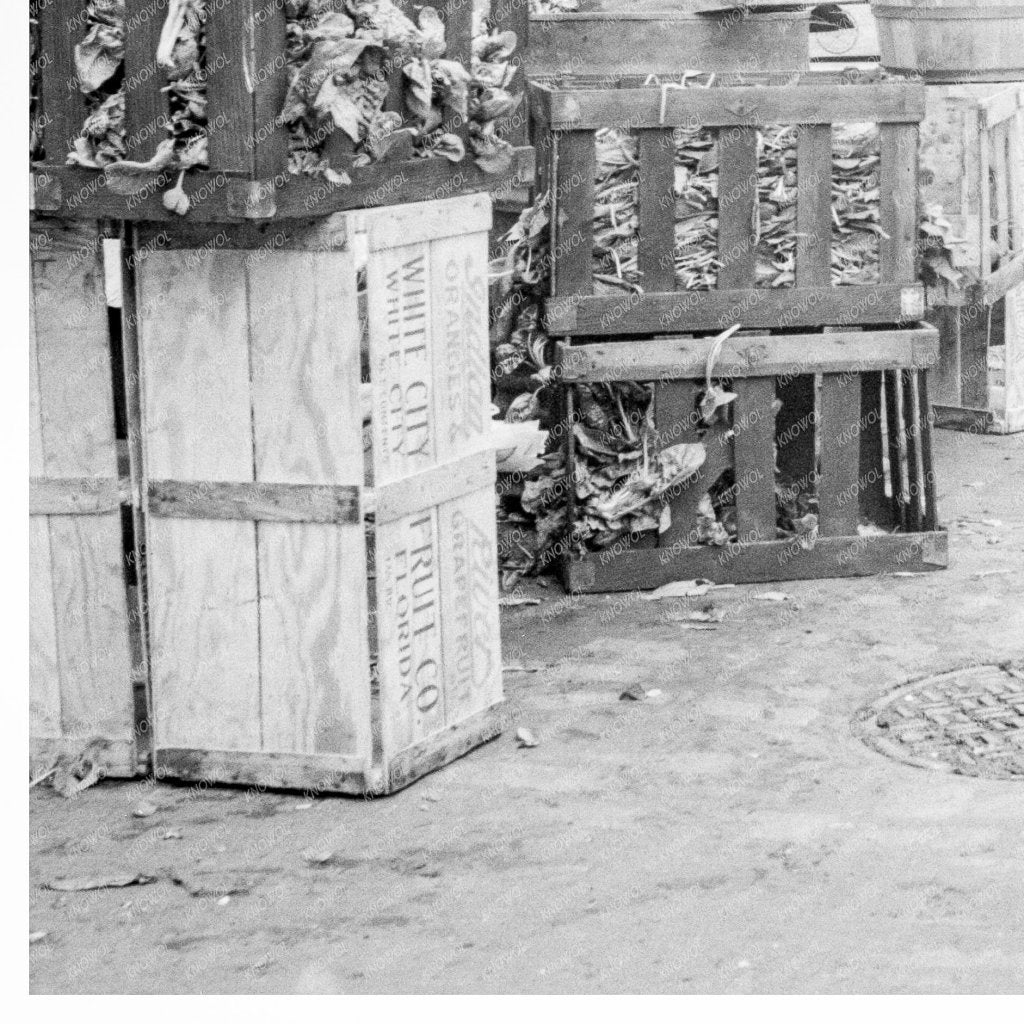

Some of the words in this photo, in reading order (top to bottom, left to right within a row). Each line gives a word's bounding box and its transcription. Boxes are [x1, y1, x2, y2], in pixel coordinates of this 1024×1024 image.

[386, 269, 401, 366] WHITE
[402, 255, 427, 366] WHITE
[444, 259, 462, 410] ORANGES
[388, 382, 405, 456] CITY
[405, 380, 430, 457] CITY
[394, 548, 412, 702] FLORIDA
[409, 515, 436, 638] FRUIT
[450, 510, 472, 702] GRAPEFRUIT
